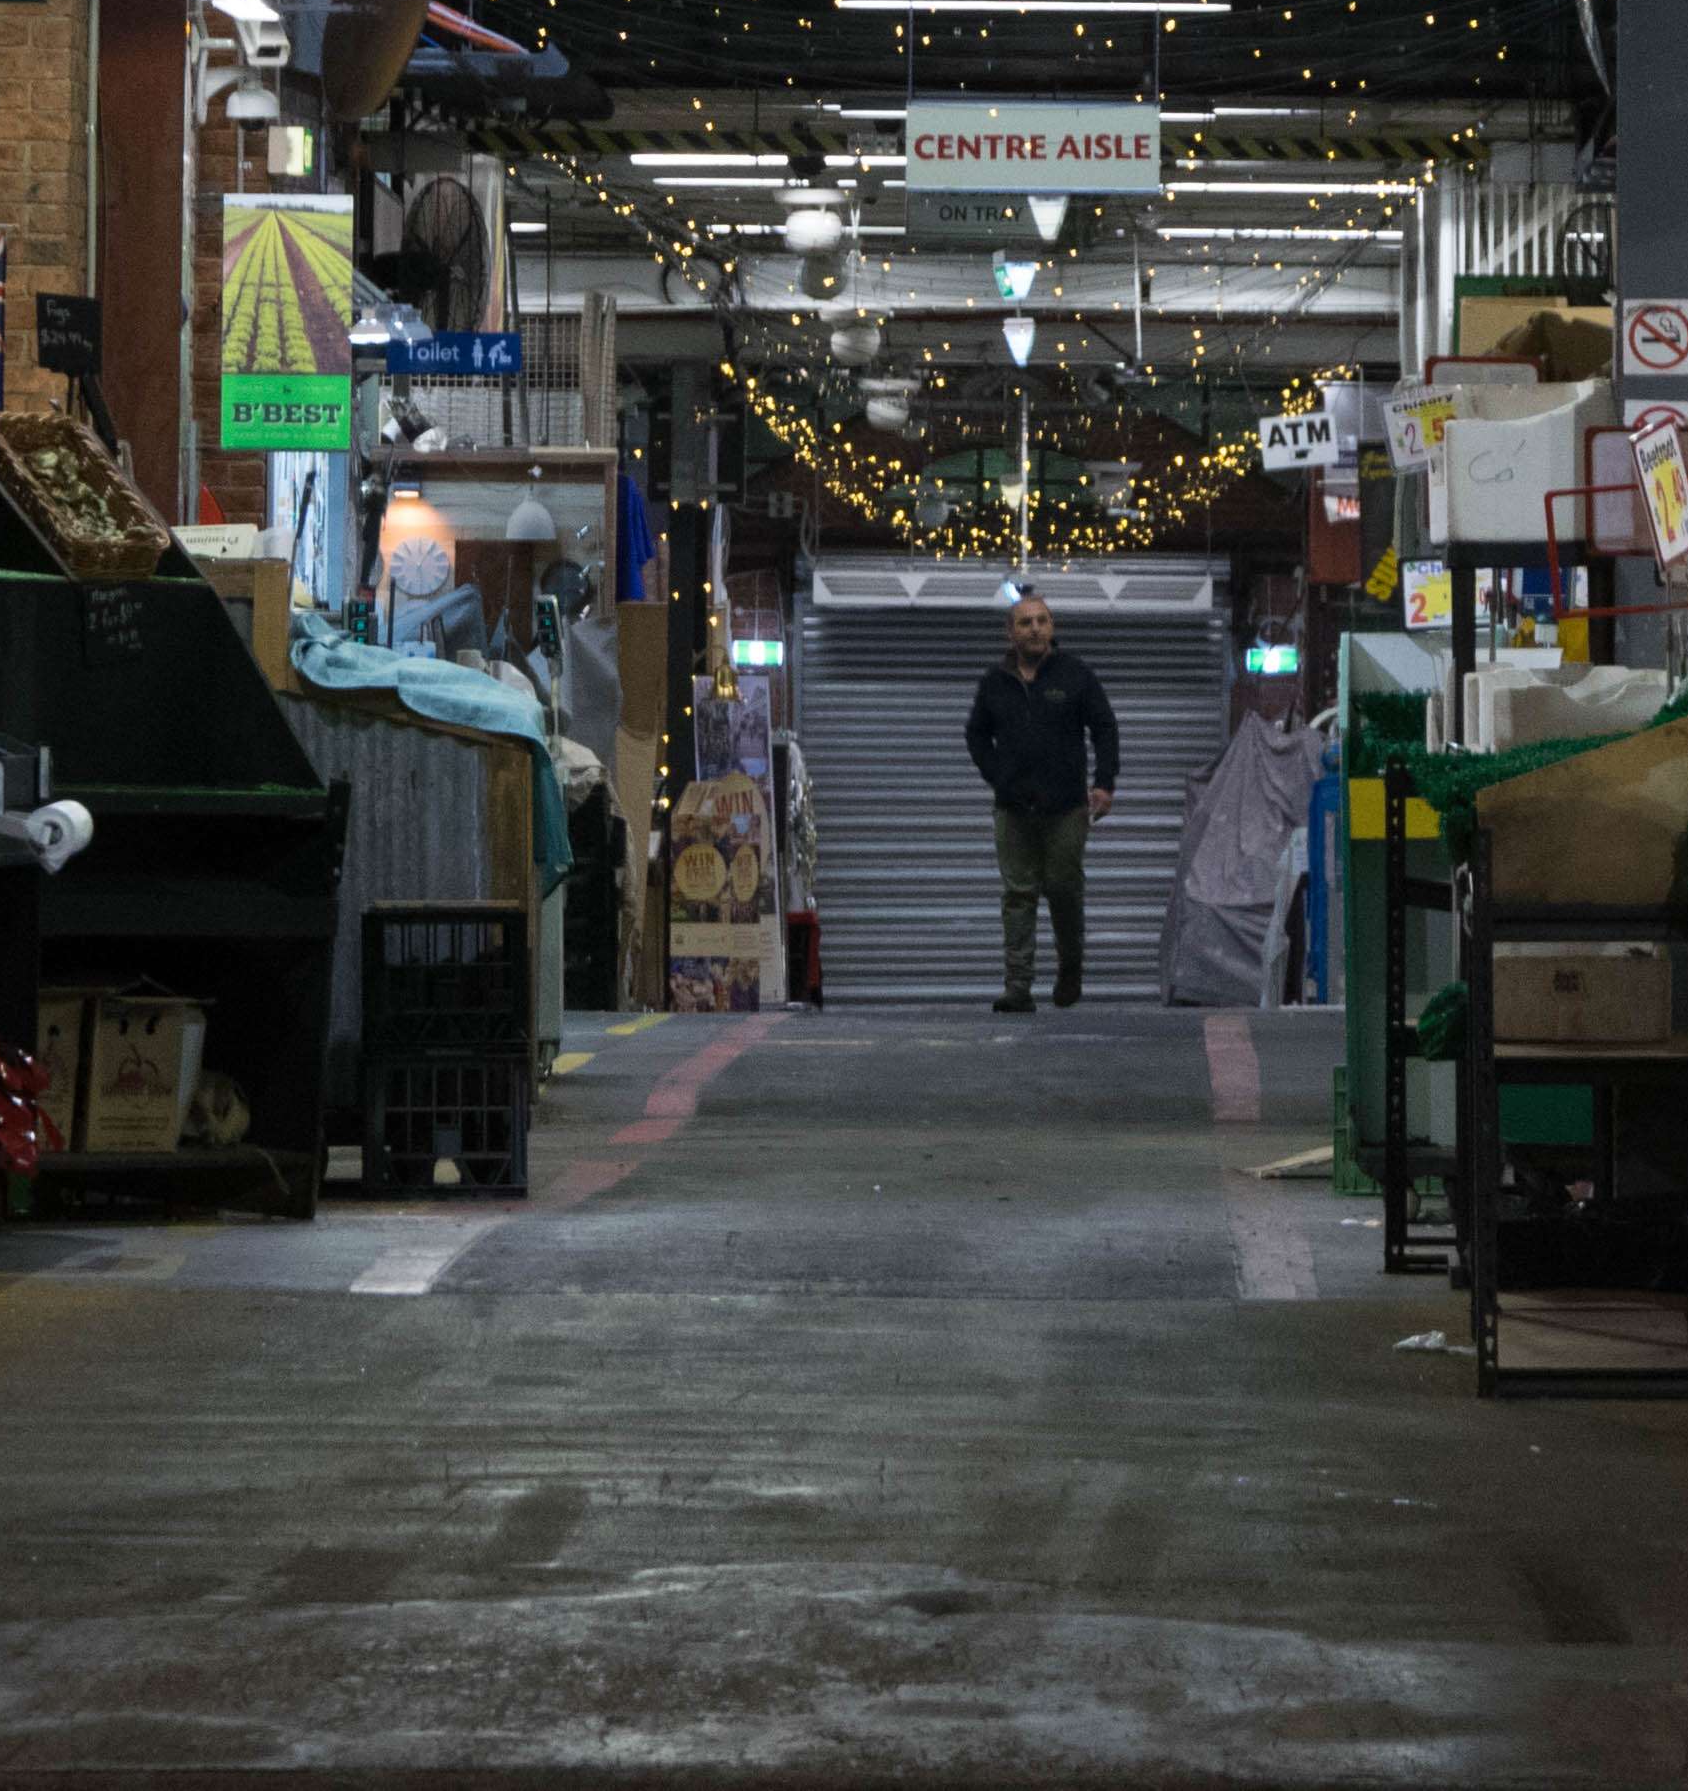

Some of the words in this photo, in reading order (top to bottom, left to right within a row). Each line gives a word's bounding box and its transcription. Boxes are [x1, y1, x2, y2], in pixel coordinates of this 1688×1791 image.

[914, 134, 1047, 160] CENTRE
[1057, 134, 1151, 160] AISLE
[938, 206, 966, 222] ON
[973, 206, 1023, 222] TRAY
[232, 402, 344, 426] B'BEST
[1392, 393, 1454, 414] Chicory
[1267, 418, 1331, 448] ATM
[1639, 435, 1678, 473] Beetroot
[715, 789, 754, 814] WIN
[684, 851, 714, 867] WIN
